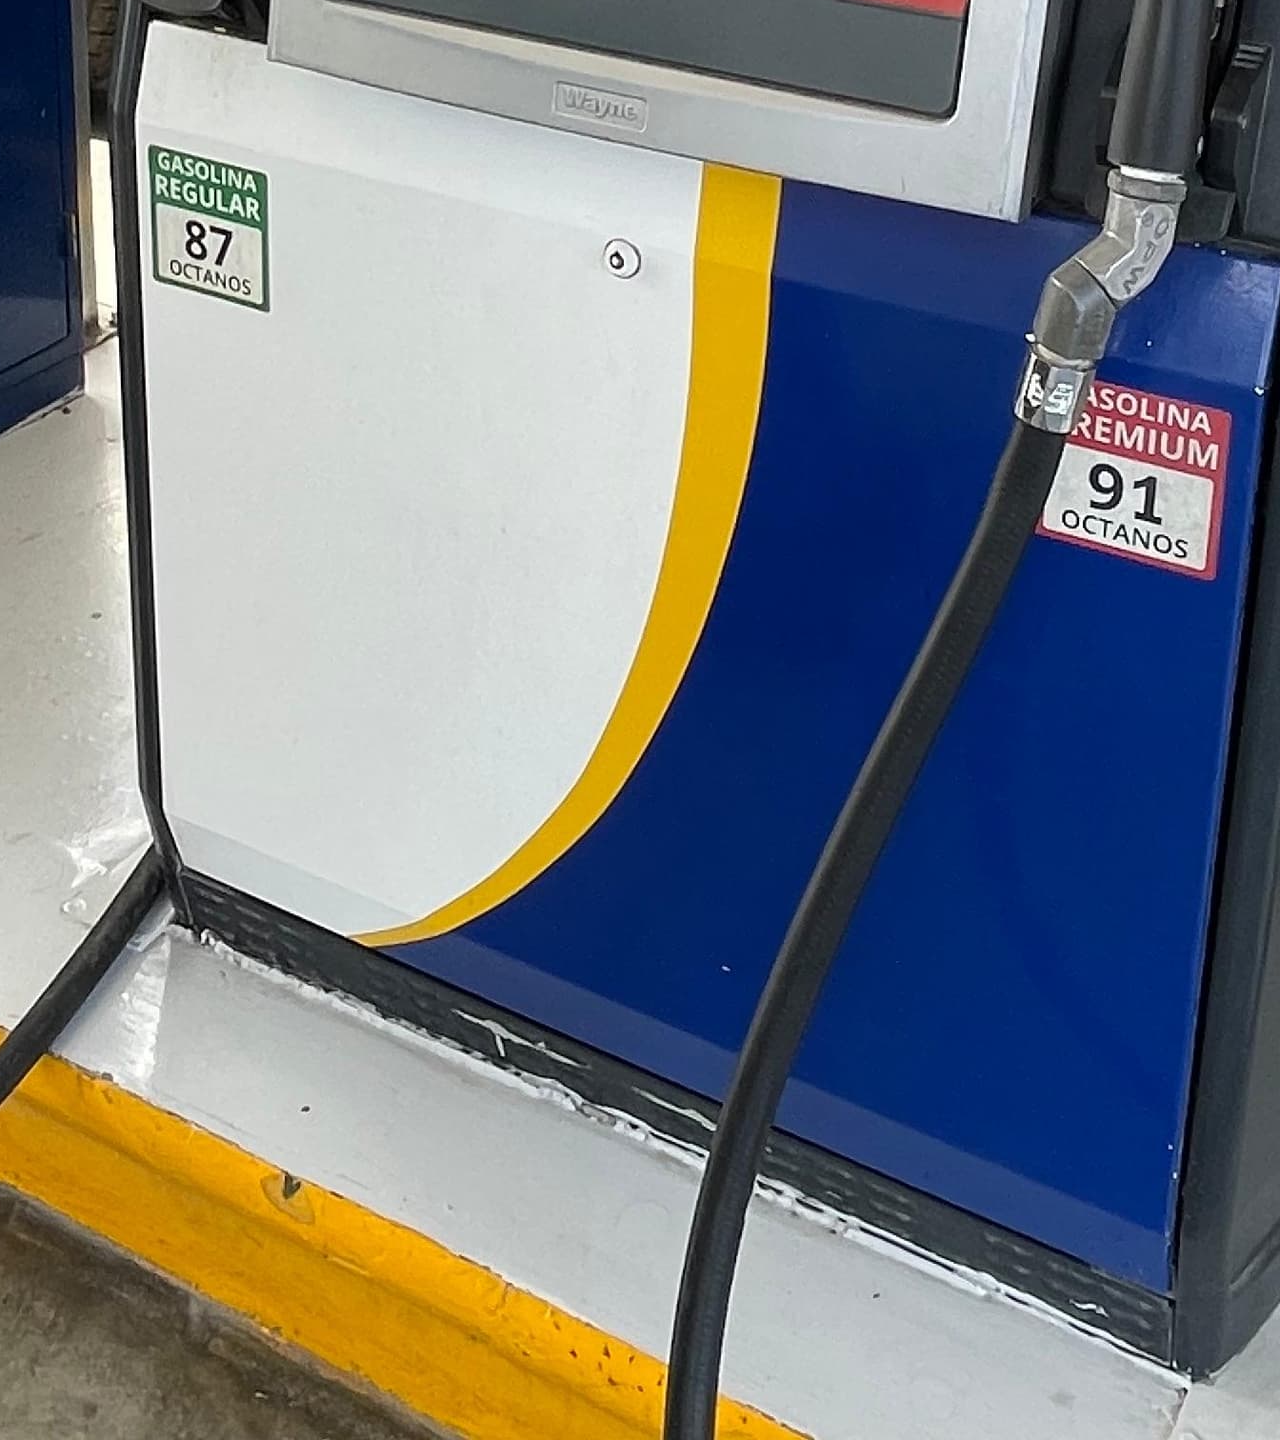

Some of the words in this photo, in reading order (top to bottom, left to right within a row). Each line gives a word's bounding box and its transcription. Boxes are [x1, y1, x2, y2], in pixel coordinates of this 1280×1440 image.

[561, 87, 639, 121] Wayne
[157, 151, 258, 193] GASOLINA
[155, 174, 261, 221] REGULAR
[185, 220, 233, 266] 87
[170, 259, 252, 296] OCTANOS
[1087, 386, 1211, 436] ASOLINA
[1071, 412, 1219, 471] REMIUM
[1088, 463, 1162, 525] 91
[1061, 509, 1189, 559] OCTANOS
